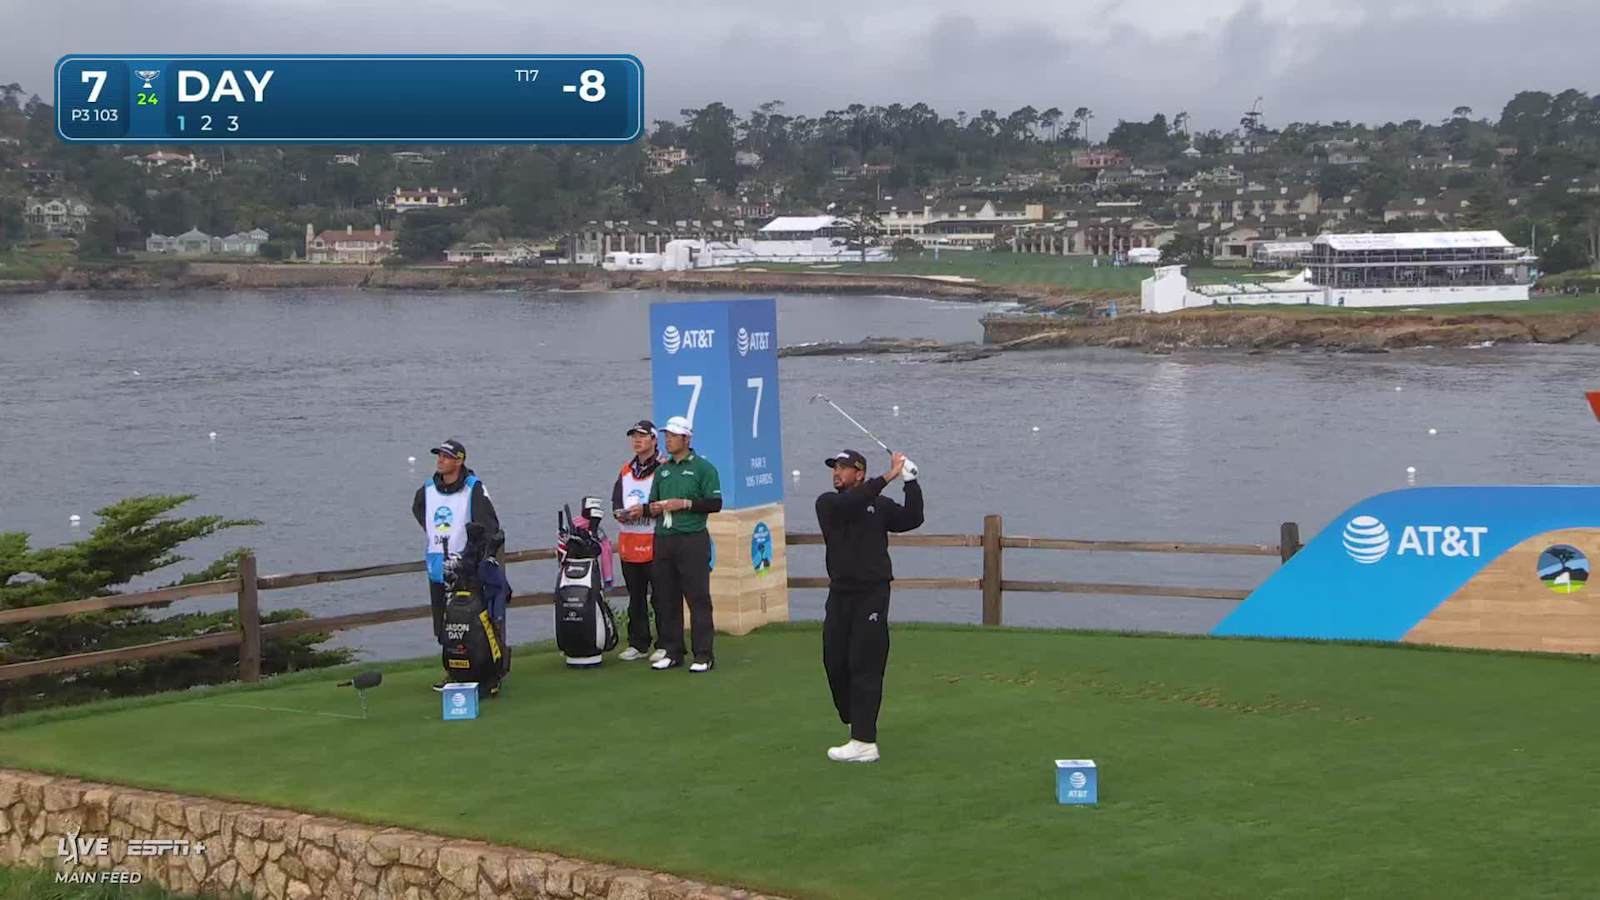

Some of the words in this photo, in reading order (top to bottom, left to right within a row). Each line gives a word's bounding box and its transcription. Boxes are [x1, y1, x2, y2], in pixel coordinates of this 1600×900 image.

[683, 329, 715, 349] AT&T
[749, 331, 770, 350] AT&T
[677, 375, 703, 430] 7
[747, 377, 764, 439] 7
[1397, 525, 1488, 557] AT&T
[445, 624, 470, 632] JASON
[448, 631, 465, 640] DAY
[1067, 790, 1089, 798] AT&T
